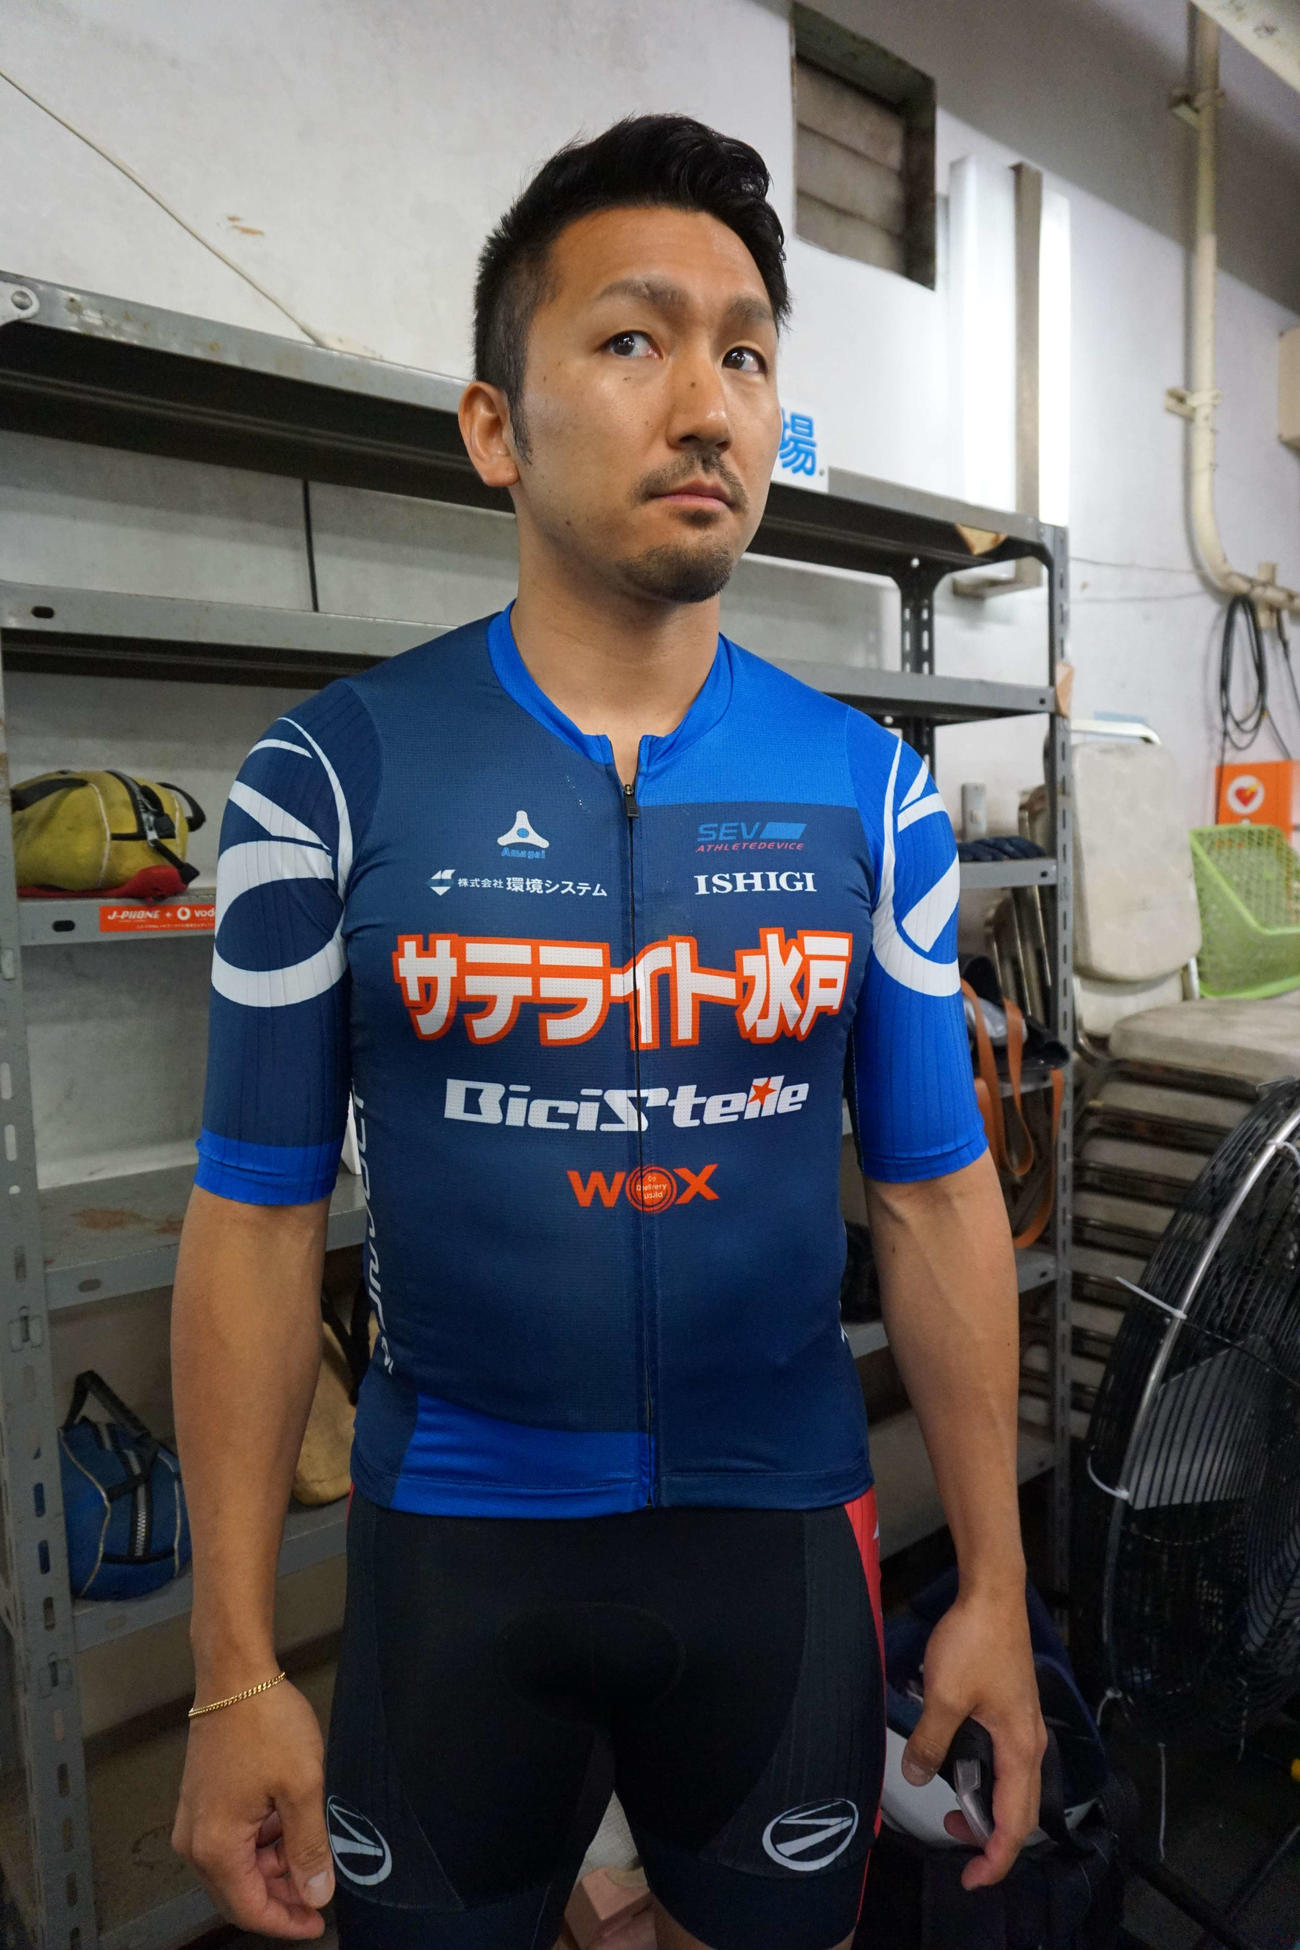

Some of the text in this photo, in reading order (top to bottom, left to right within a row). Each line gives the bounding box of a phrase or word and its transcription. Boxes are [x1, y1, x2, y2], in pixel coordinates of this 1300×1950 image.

[696, 822, 761, 842] SEV
[695, 841, 805, 854] ATHLETEDEVICE
[693, 871, 818, 895] ISHIGI
[107, 909, 161, 920] J-PHONE
[393, 927, 853, 1050] サテライト水戸
